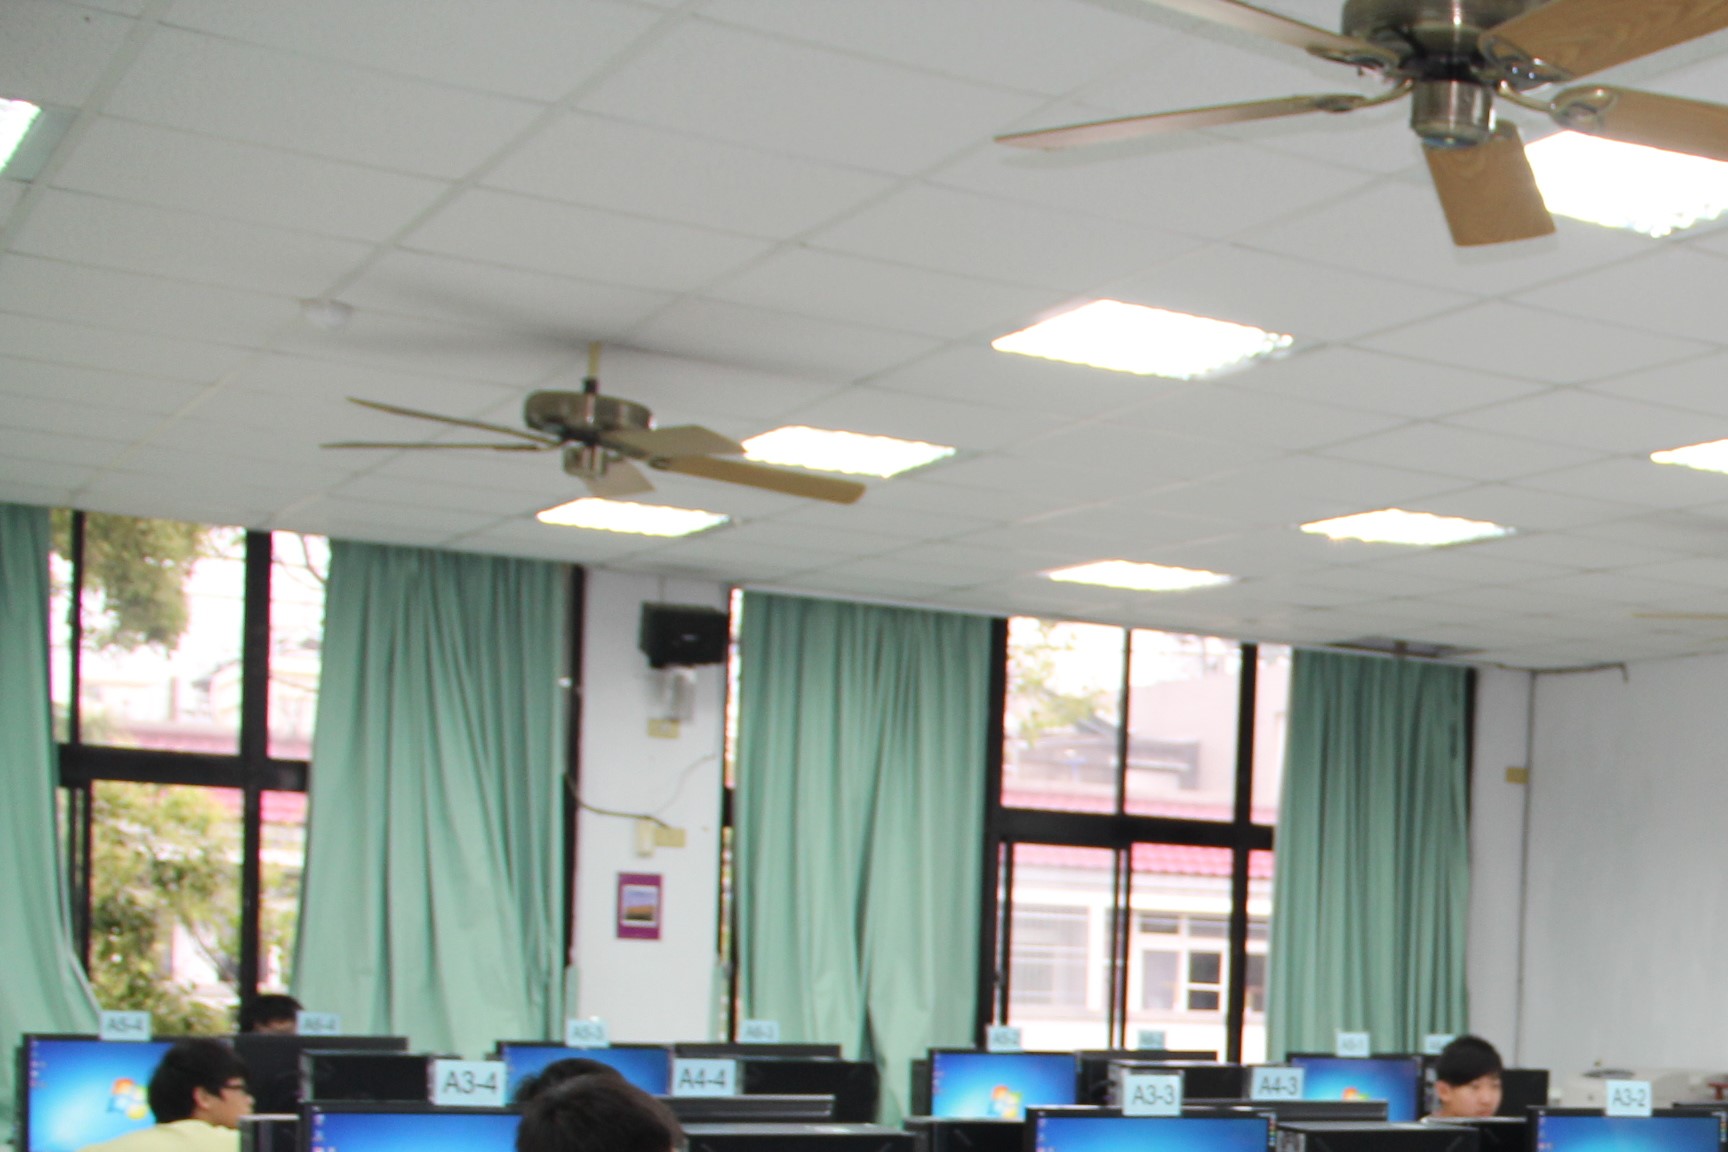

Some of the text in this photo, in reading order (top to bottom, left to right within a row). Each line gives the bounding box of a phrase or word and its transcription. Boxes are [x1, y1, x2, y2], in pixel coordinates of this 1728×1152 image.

[443, 1069, 498, 1095] A3-4
[678, 1067, 726, 1090] A4-4
[1258, 1075, 1298, 1096] A4-3
[1132, 1084, 1176, 1105] A3-3
[1612, 1086, 1646, 1107] A3-2
